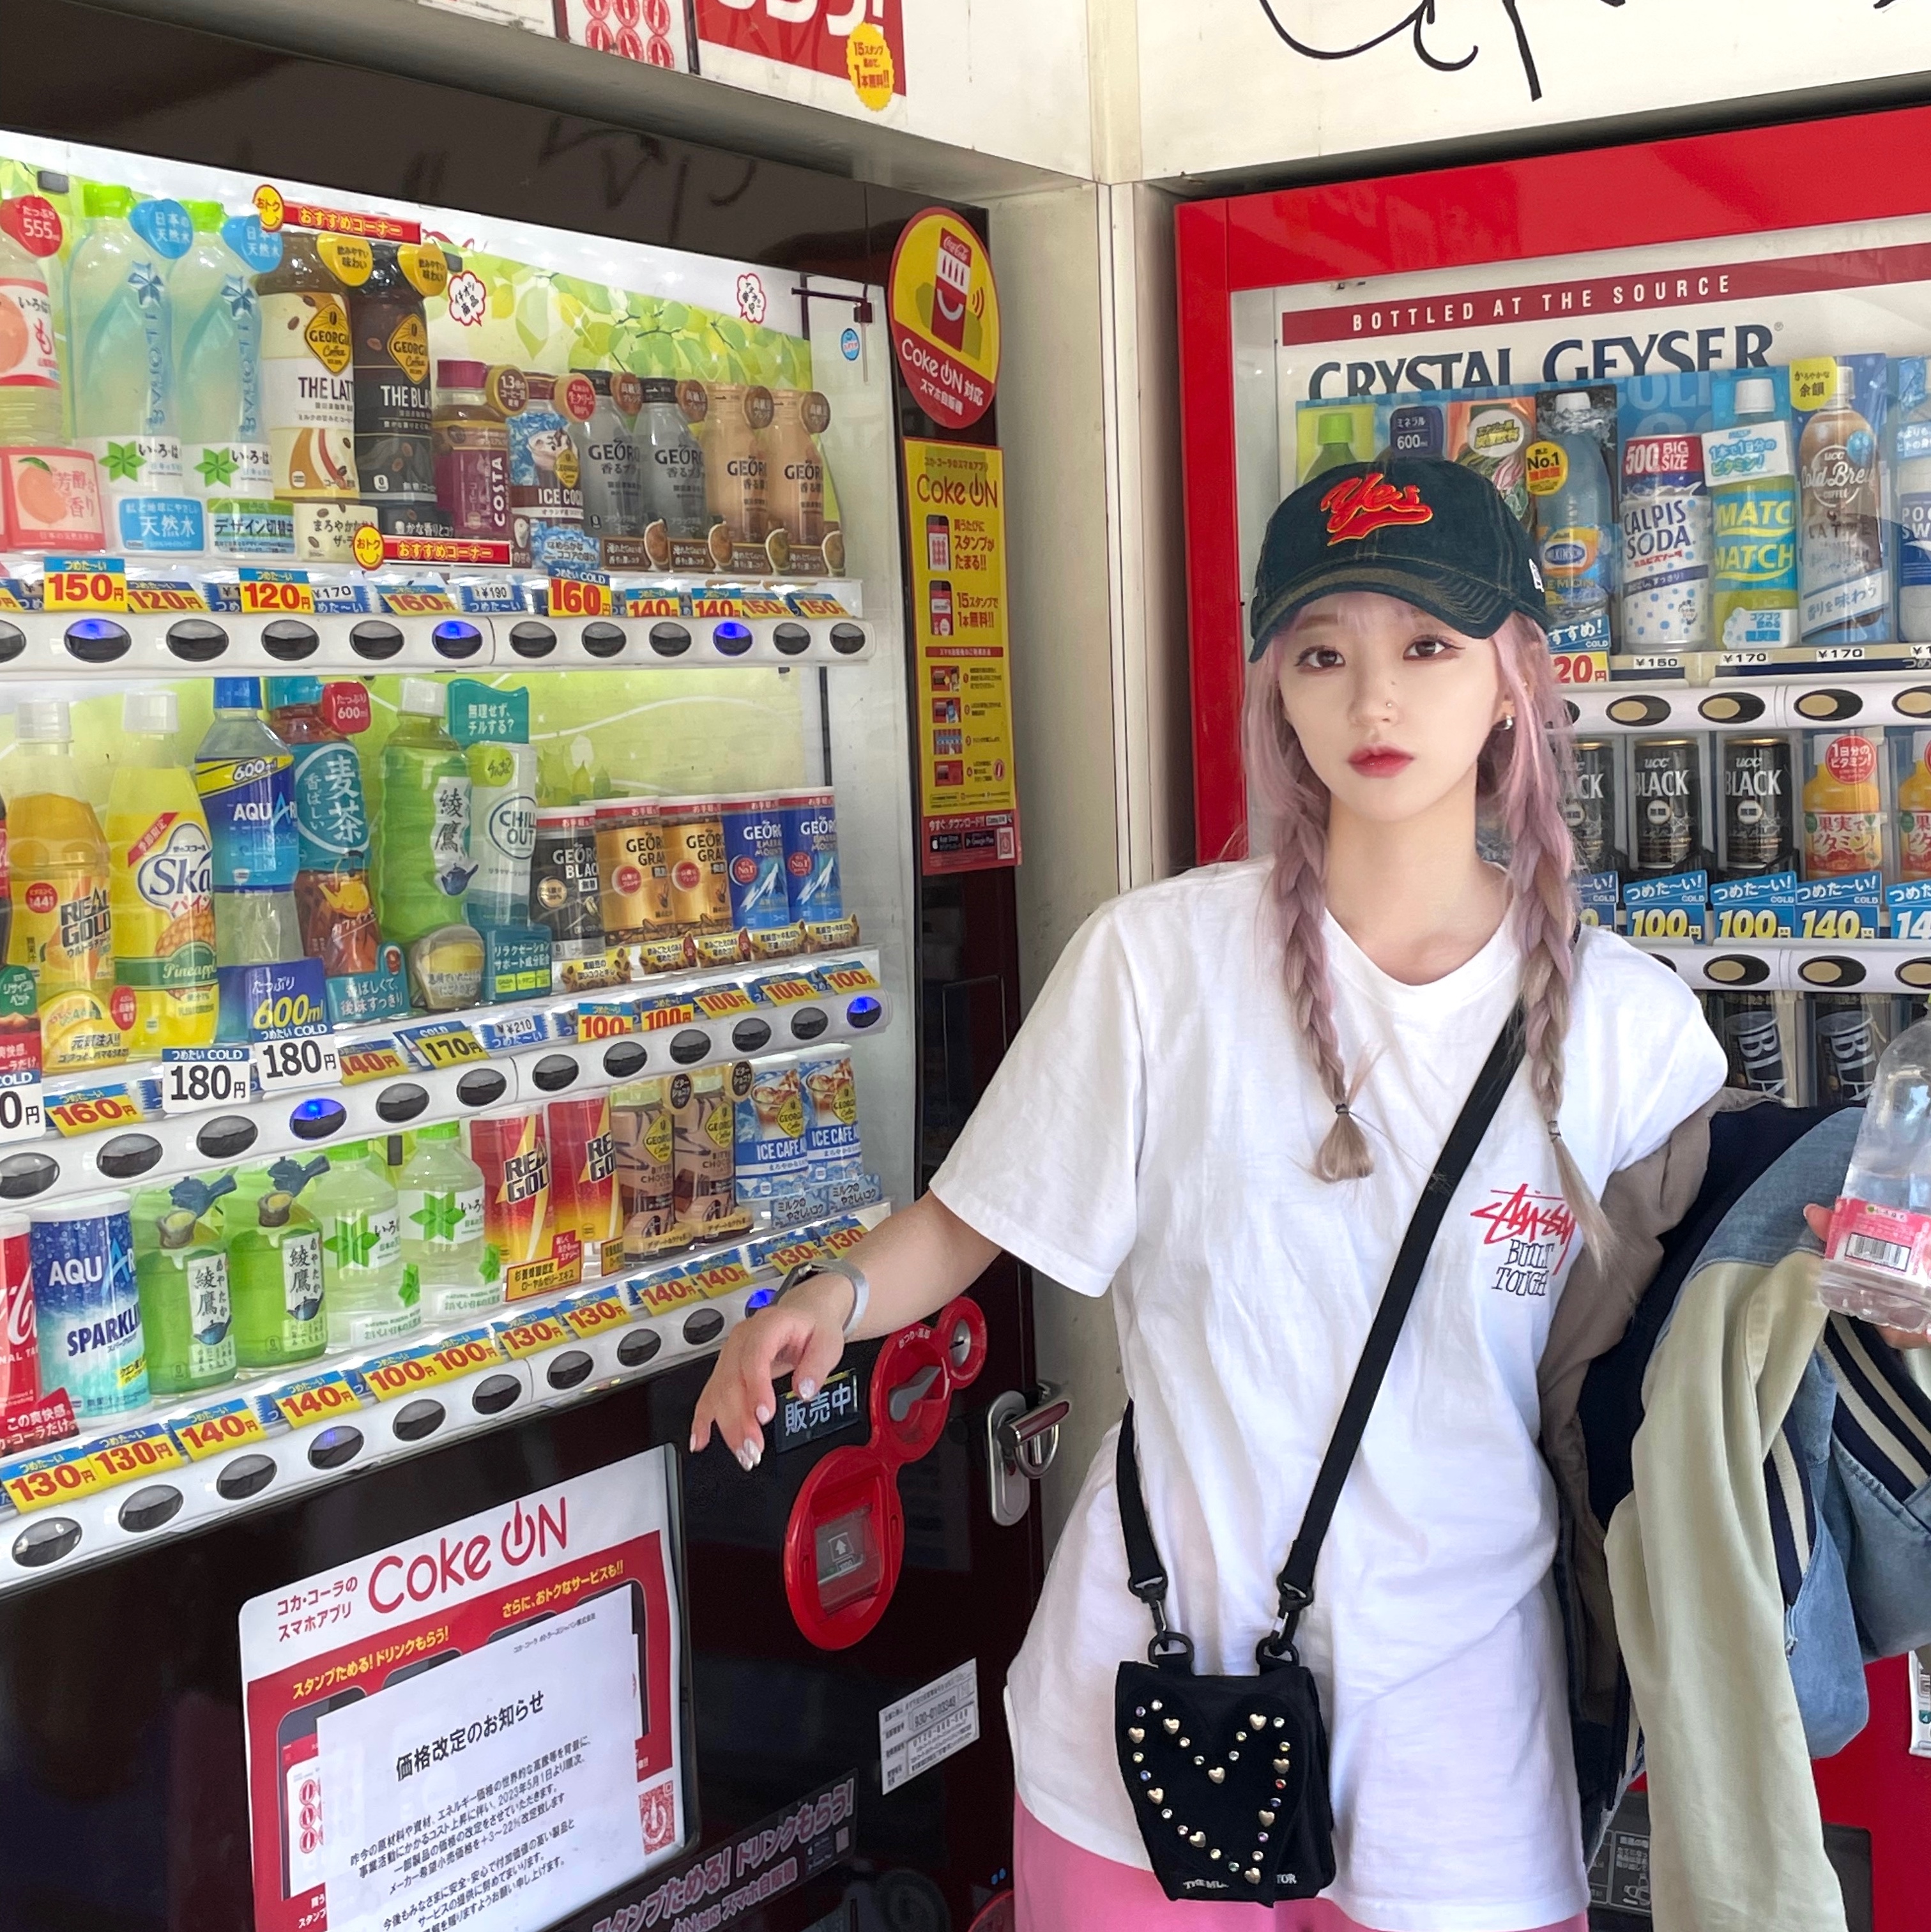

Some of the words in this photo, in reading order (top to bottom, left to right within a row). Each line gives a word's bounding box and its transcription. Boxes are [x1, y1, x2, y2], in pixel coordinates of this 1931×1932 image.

[300, 208, 403, 237] おすすめコーナー
[155, 228, 190, 243] 天然水
[1352, 301, 1475, 333] BOTTLED
[1492, 296, 1523, 318] AT
[1541, 289, 1592, 312] THE
[1613, 274, 1730, 305] SOURCE
[901, 337, 938, 378] Coke
[940, 359, 963, 395] ON
[963, 380, 984, 408] 対応
[1309, 347, 1513, 400] CRYSTAL
[1543, 324, 1775, 383] GEYSER
[298, 376, 328, 399] THE
[380, 384, 409, 407] THE
[1799, 382, 1825, 398] 余韻
[1397, 416, 1425, 428] ミネラル
[1663, 441, 1689, 455] BIG
[1527, 455, 1560, 472] No.1
[1661, 454, 1689, 471] SIZE
[1711, 456, 1766, 478] ビタミン!
[491, 457, 507, 528] COSTA
[538, 487, 561, 505] ICE
[916, 473, 966, 505] Coke
[968, 474, 998, 509] ON
[1320, 473, 1433, 544] Yes
[1623, 499, 1687, 536] CALPIS
[141, 515, 195, 538] 天然水
[215, 517, 294, 537] デザイン切替中
[397, 542, 493, 561] おすすめコーナー
[954, 535, 995, 552] スタンプが
[1626, 527, 1692, 561] SODA
[49, 573, 124, 602] 150円
[579, 571, 606, 585] COLD
[129, 590, 203, 610] 120円
[245, 583, 311, 609] 120円
[551, 577, 611, 616] 160円
[1585, 639, 1609, 649] COLD
[1817, 649, 1863, 659] ¥170
[1636, 657, 1678, 668] ¥150
[1723, 653, 1767, 663] ¥170
[337, 694, 367, 705] たっぷり
[468, 703, 511, 719] 無理せず、
[468, 719, 514, 736] チルする?
[1831, 742, 1871, 757] 1日分の
[1831, 753, 1872, 768] ビタミン!
[303, 774, 325, 831] 香ばしい
[324, 755, 363, 842] 麦茶
[434, 787, 464, 853] 綾鷹
[1819, 814, 1864, 832] 果実で
[506, 827, 535, 846] OUT
[1770, 895, 1794, 904] COLD
[1854, 895, 1879, 904] COLD
[1630, 908, 1702, 941] 100円
[494, 941, 551, 958] リラクゼーション
[766, 980, 813, 1001] 100円
[830, 970, 876, 988] 100円
[340, 994, 404, 1018] 後味すっきり
[701, 989, 749, 1010] 100円
[252, 994, 323, 1030] 600ml
[261, 1030, 293, 1042] つめたい
[294, 1023, 328, 1037] COLD
[419, 1027, 449, 1039] COLD
[172, 1049, 205, 1061] つめたい
[207, 1047, 243, 1060] COLD
[263, 1039, 337, 1079] 180円
[426, 1035, 484, 1063] 170円
[170, 1065, 247, 1101] 180円
[52, 1098, 137, 1128] 160円
[811, 1130, 829, 1147] ICE
[830, 1126, 854, 1145] CAFE
[756, 1143, 775, 1161] ICE
[834, 1183, 860, 1198] ミルクの
[841, 1189, 876, 1205] やさしいコク
[778, 1198, 807, 1212] ミルクの
[786, 1204, 825, 1221] やさしいコク
[772, 1245, 822, 1266] 130円
[1504, 1238, 1555, 1269] BUILT
[289, 1246, 312, 1294] 綾鷹
[696, 1265, 749, 1290] 140円
[1491, 1266, 1550, 1297] TOUGH
[195, 1266, 218, 1317] 綾鷹
[641, 1280, 695, 1307] 140円
[569, 1300, 626, 1329] 130円
[501, 1322, 563, 1351] 130円
[434, 1341, 498, 1371] 100円
[370, 1360, 436, 1391] 100円
[282, 1385, 354, 1418] 140円
[784, 1382, 851, 1436] 販売中
[6, 1411, 71, 1433] この爽快感。
[180, 1414, 257, 1450] 140円
[95, 1440, 174, 1475] 130円
[11, 1466, 96, 1502] 130円
[368, 1534, 492, 1614] Coke
[501, 1496, 567, 1567] ON
[277, 1576, 358, 1617] コカ・コーラの
[277, 1601, 354, 1642] スマホアプリ
[395, 1691, 546, 1783] 価格改定のお知らせ
